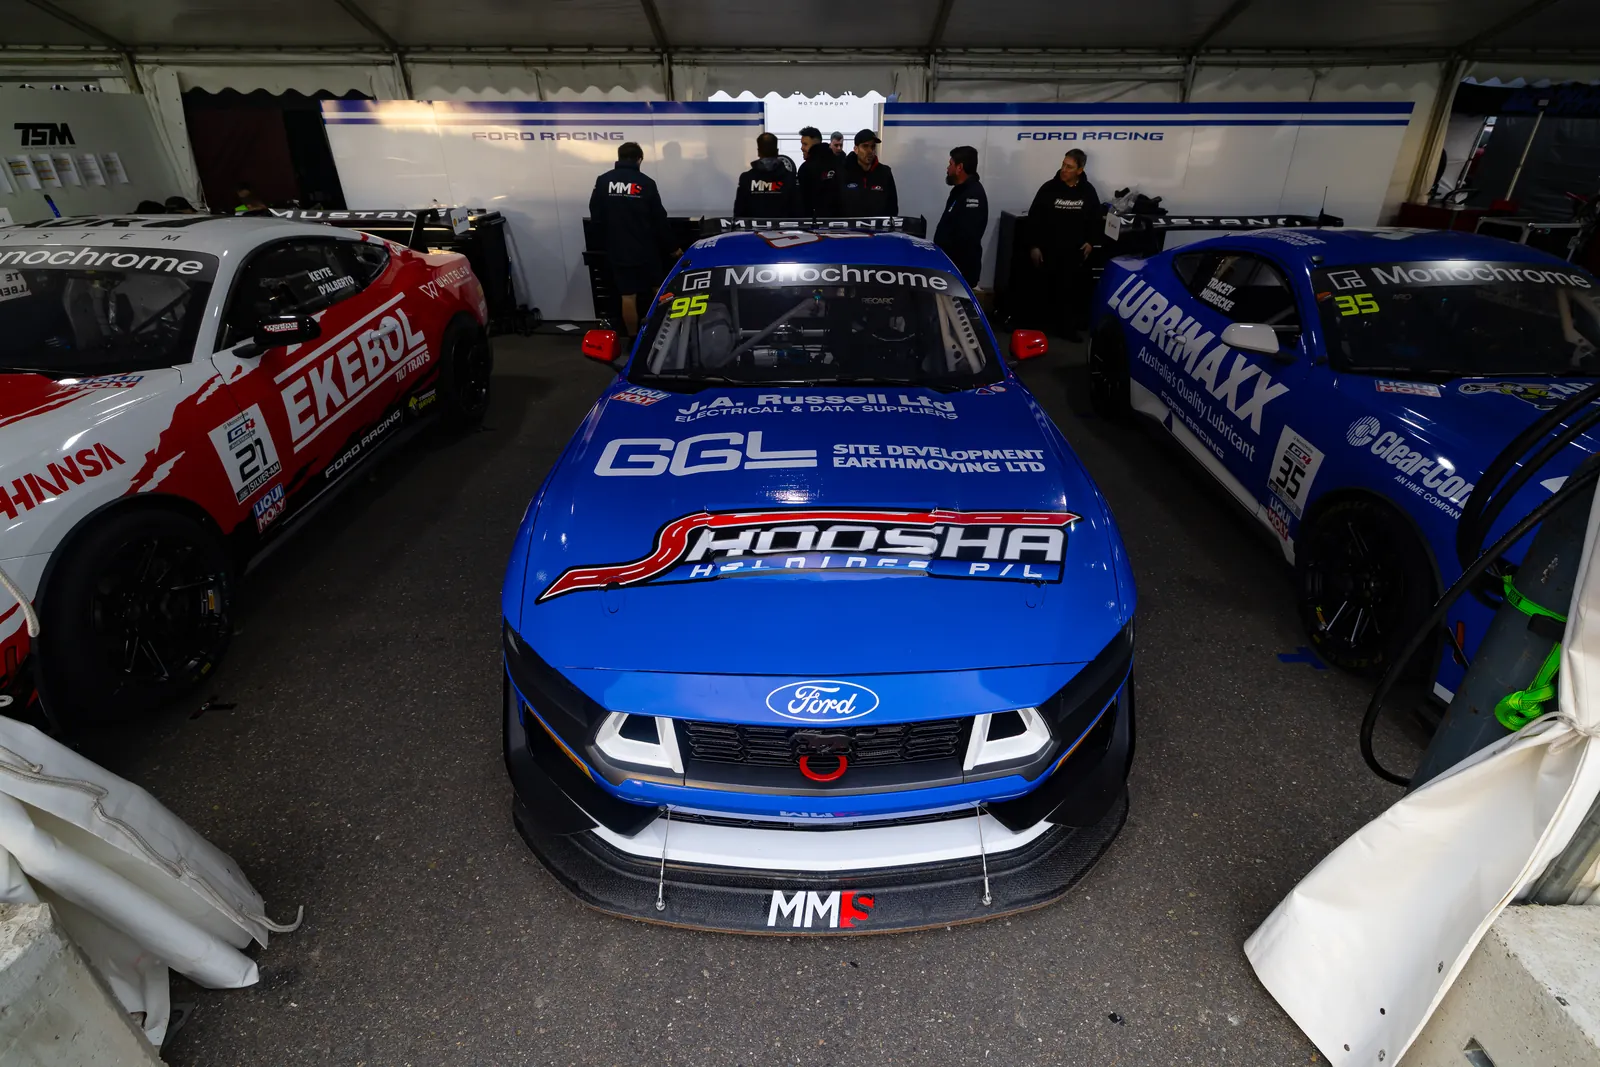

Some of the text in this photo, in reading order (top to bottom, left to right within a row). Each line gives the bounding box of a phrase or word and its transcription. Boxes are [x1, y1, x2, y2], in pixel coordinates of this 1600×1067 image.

[14, 123, 76, 146] TSM
[471, 132, 624, 141] FORD RACING
[1017, 131, 1164, 141] FORD RACING
[720, 218, 904, 228] MUSTANG
[0, 247, 204, 275] nochrome
[308, 267, 333, 282] KEYTE
[318, 275, 355, 296] D'ALBERTO
[724, 264, 948, 291] Monochrome
[1206, 277, 1236, 297] TRACEY
[1370, 263, 1592, 289] Monochrome
[670, 293, 710, 319] 95
[1199, 287, 1236, 312] MIEDECKE
[1334, 292, 1380, 317] 35
[395, 350, 431, 383] TILT TRAYS
[1108, 273, 1290, 436] LUBRIMAXX
[280, 308, 426, 443] EKEBOL
[612, 392, 659, 406] MOLY
[626, 386, 671, 400] LIQUI
[678, 394, 955, 415] J.A. Russell Ltd
[1137, 346, 1177, 388] Australia's
[1177, 378, 1208, 419] Quality
[1207, 405, 1256, 462] Lubricant
[675, 405, 784, 423] ELECTRICAL
[790, 405, 803, 413] &
[862, 405, 959, 420] SUPPLIERS
[1161, 390, 1225, 460] FORD RACING
[325, 409, 401, 478] FORD RACING
[594, 430, 818, 477] GGL
[833, 444, 1044, 461] SITE DEVELOPMENT
[235, 437, 268, 483] 21
[833, 457, 1046, 474] EARTHMOVING LTD
[249, 461, 280, 492] SILVER-AM
[1276, 454, 1306, 500] 35
[254, 483, 285, 517] LIQUI
[1269, 494, 1292, 526] LIQUI
[1394, 474, 1462, 520] AN HME COMPAN
[258, 497, 287, 533] MOLY
[1267, 507, 1289, 541] MOLY
[969, 562, 1042, 578] P/L
[788, 685, 858, 714] Ford
